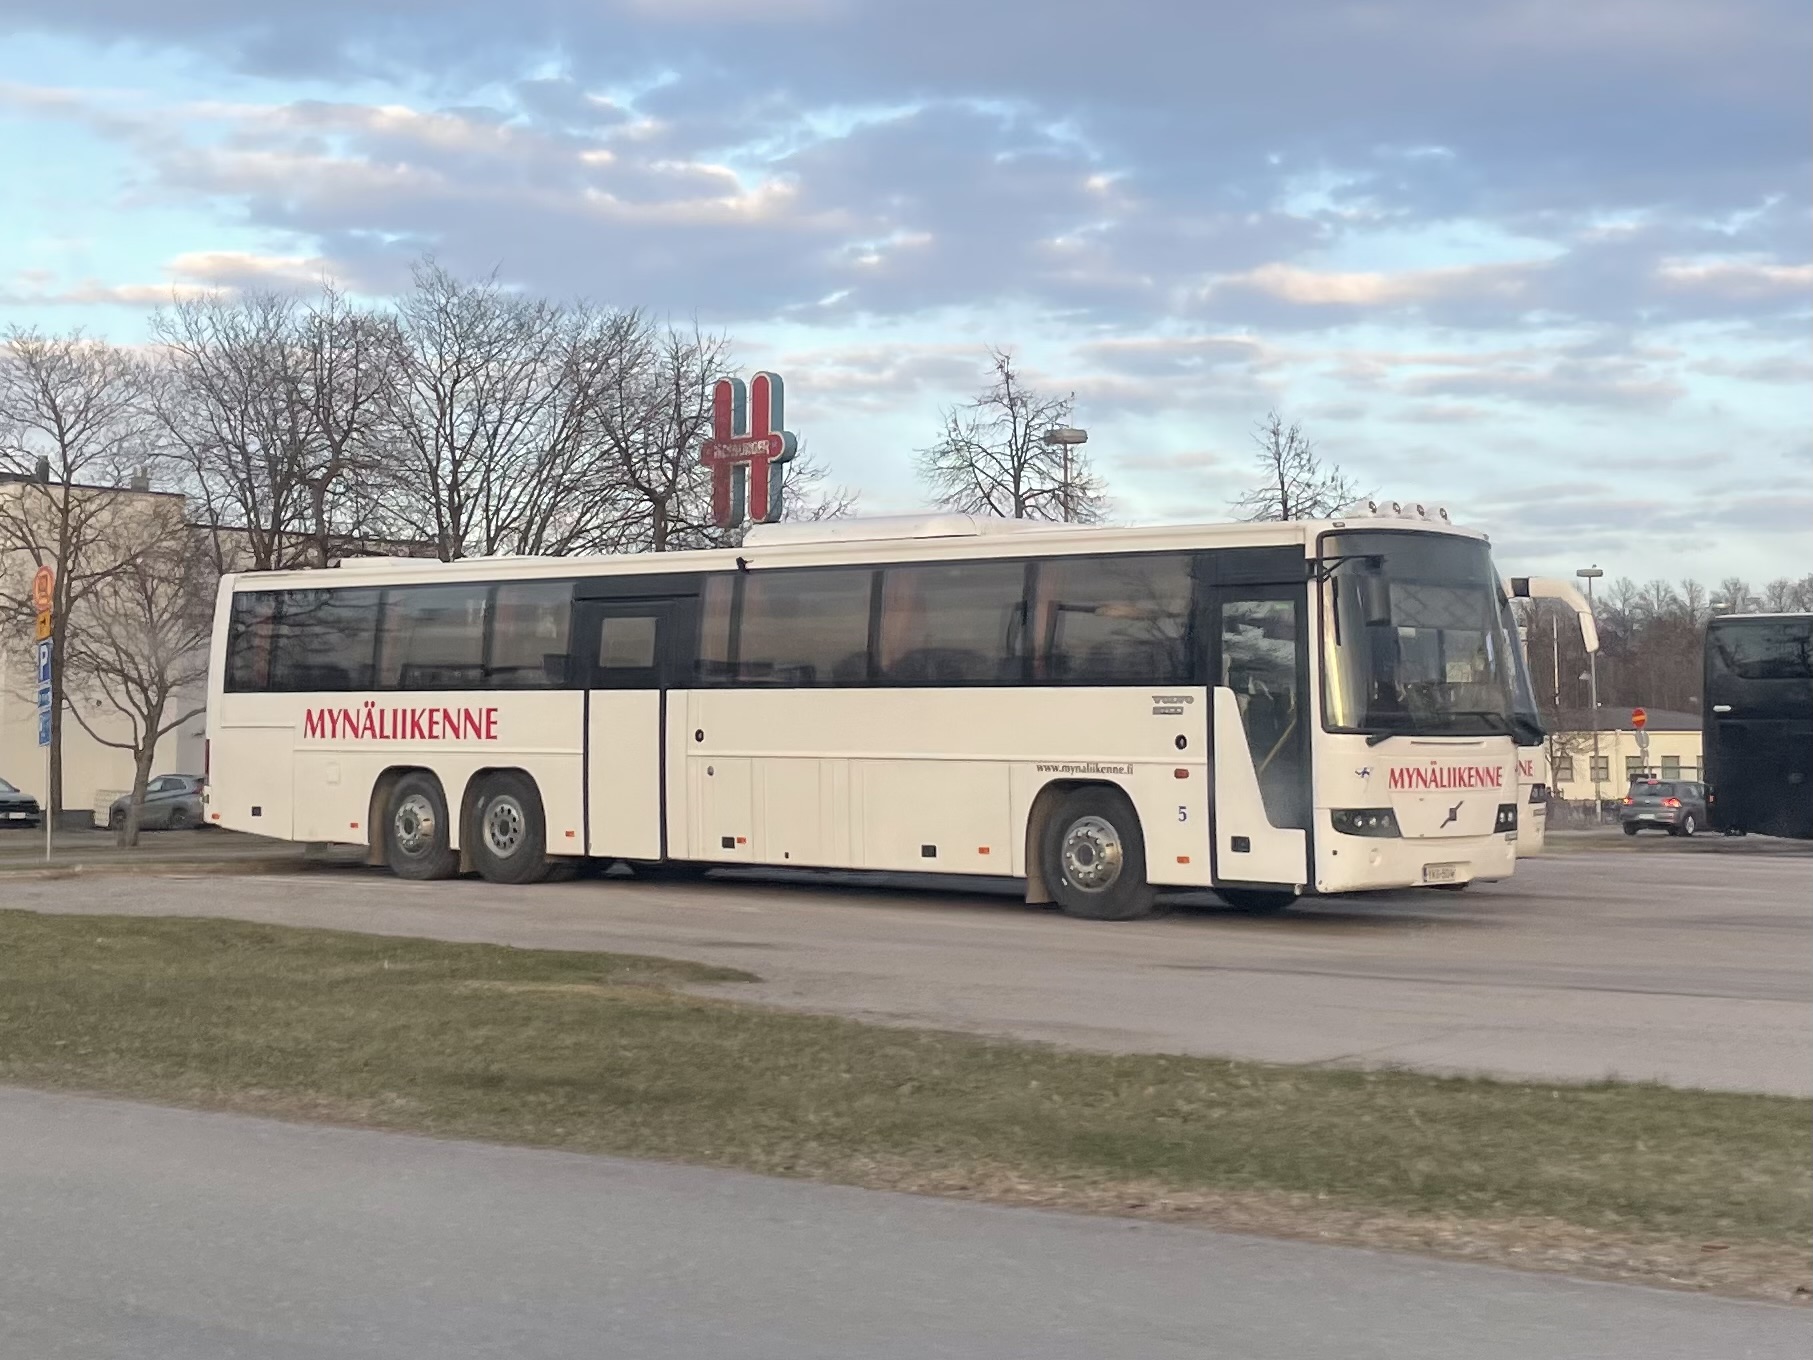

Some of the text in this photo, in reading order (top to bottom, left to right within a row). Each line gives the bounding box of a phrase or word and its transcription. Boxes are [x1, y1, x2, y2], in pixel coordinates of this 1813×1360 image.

[39, 644, 49, 681] P
[304, 700, 498, 740] MYNÄLIIKENNE
[1036, 763, 1134, 775] www.mynaliikenne.fi
[1388, 761, 1503, 790] MYNÄLIIKENNE
[1178, 806, 1187, 822] 5
